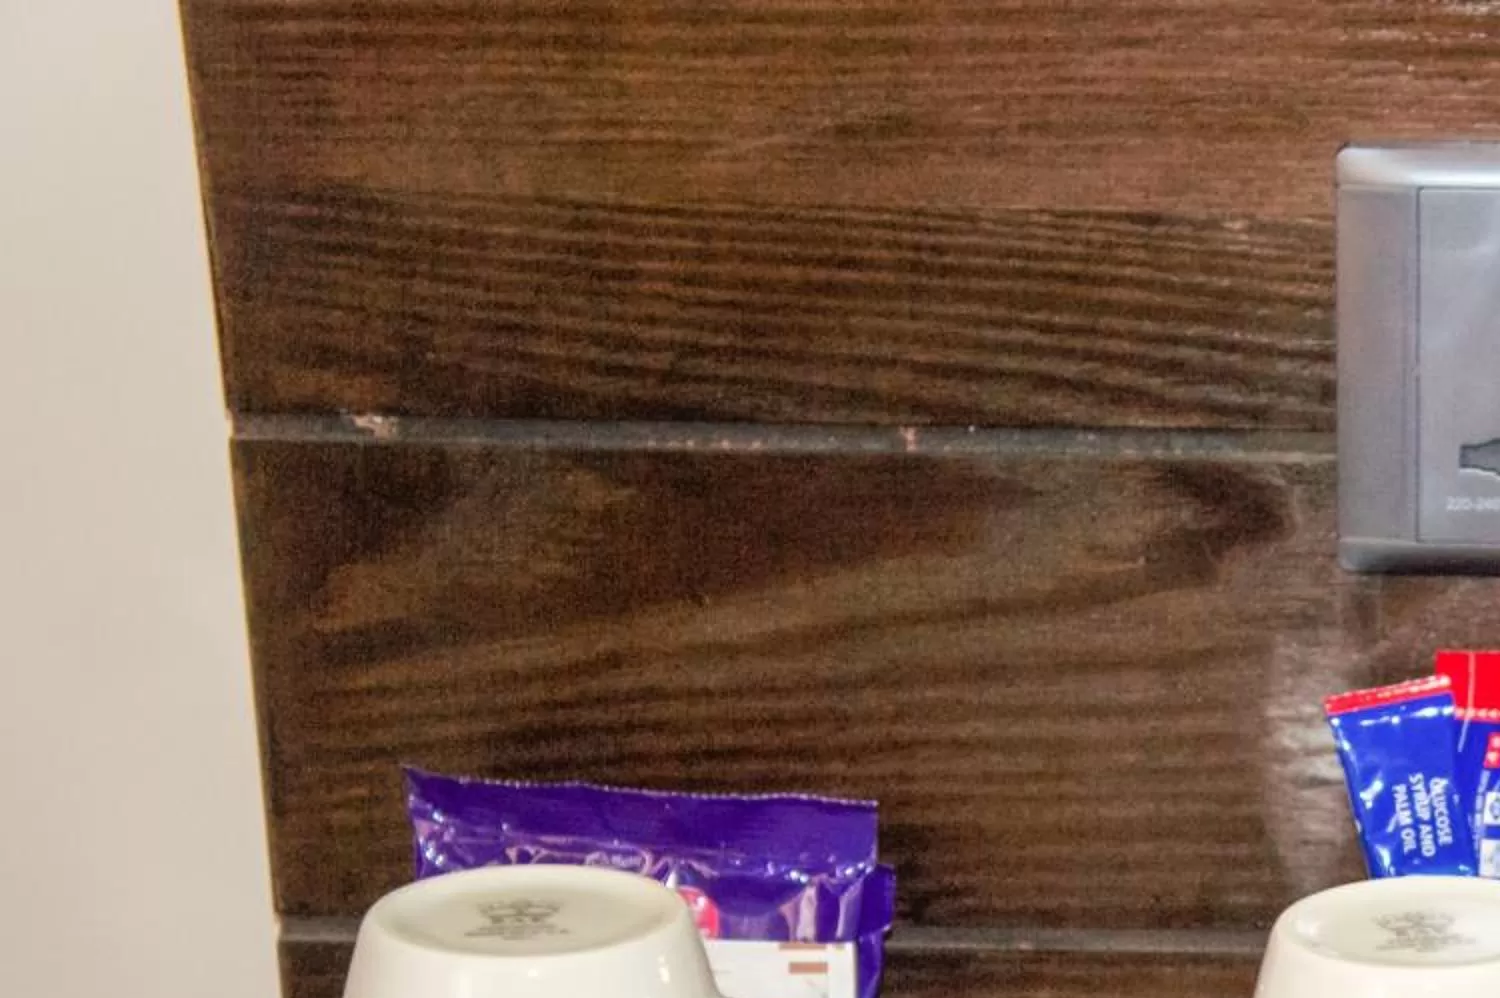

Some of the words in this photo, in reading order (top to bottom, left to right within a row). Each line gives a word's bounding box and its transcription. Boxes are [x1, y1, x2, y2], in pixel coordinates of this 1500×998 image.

[1392, 784, 1414, 826] PALM
[1408, 773, 1430, 821] SYRUP
[1419, 824, 1436, 857] AND
[1430, 777, 1453, 846] GLUCOSE
[1401, 828, 1416, 855] OIL
